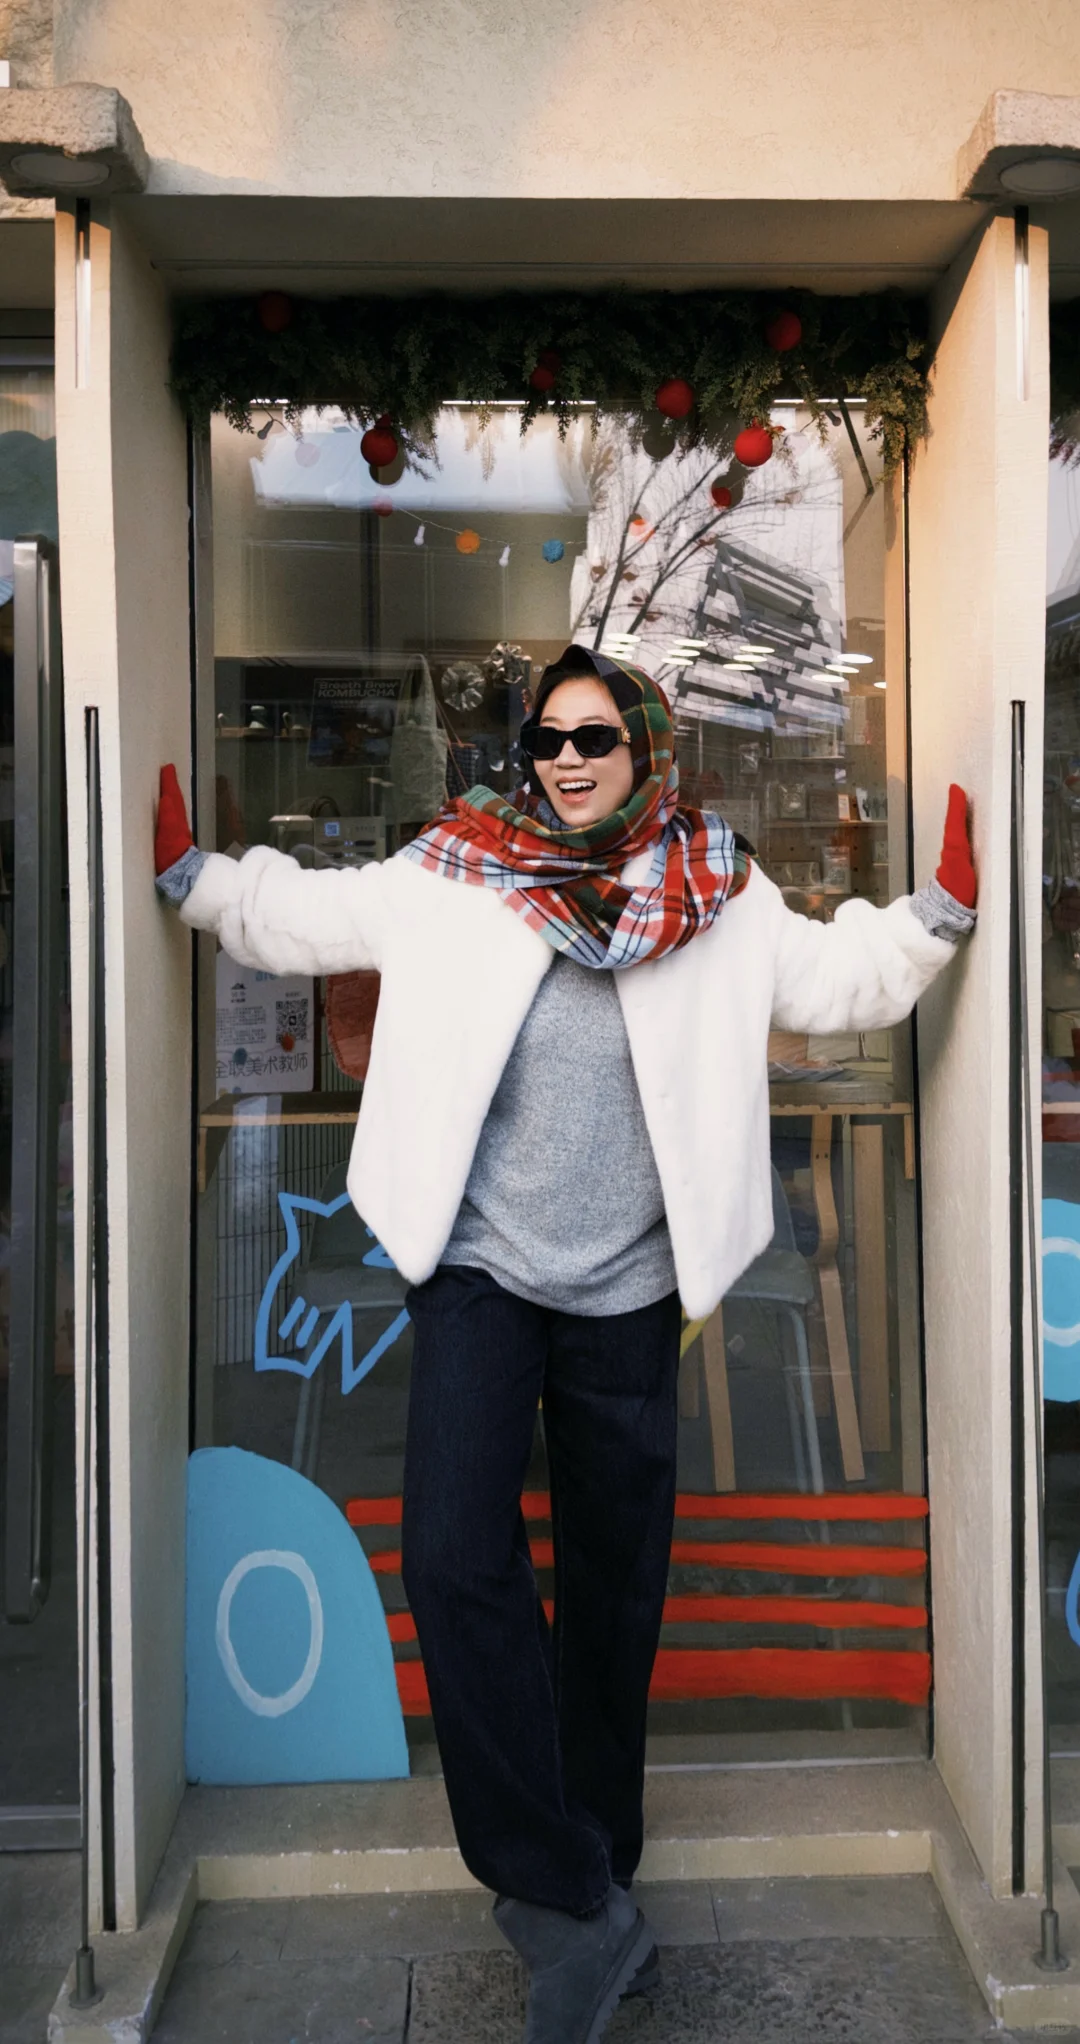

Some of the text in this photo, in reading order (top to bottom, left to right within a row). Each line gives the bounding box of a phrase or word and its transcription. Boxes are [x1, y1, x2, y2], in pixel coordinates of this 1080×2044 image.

[319, 680, 397, 689] Breath Brew
[318, 688, 395, 697] KOMBUCHA
